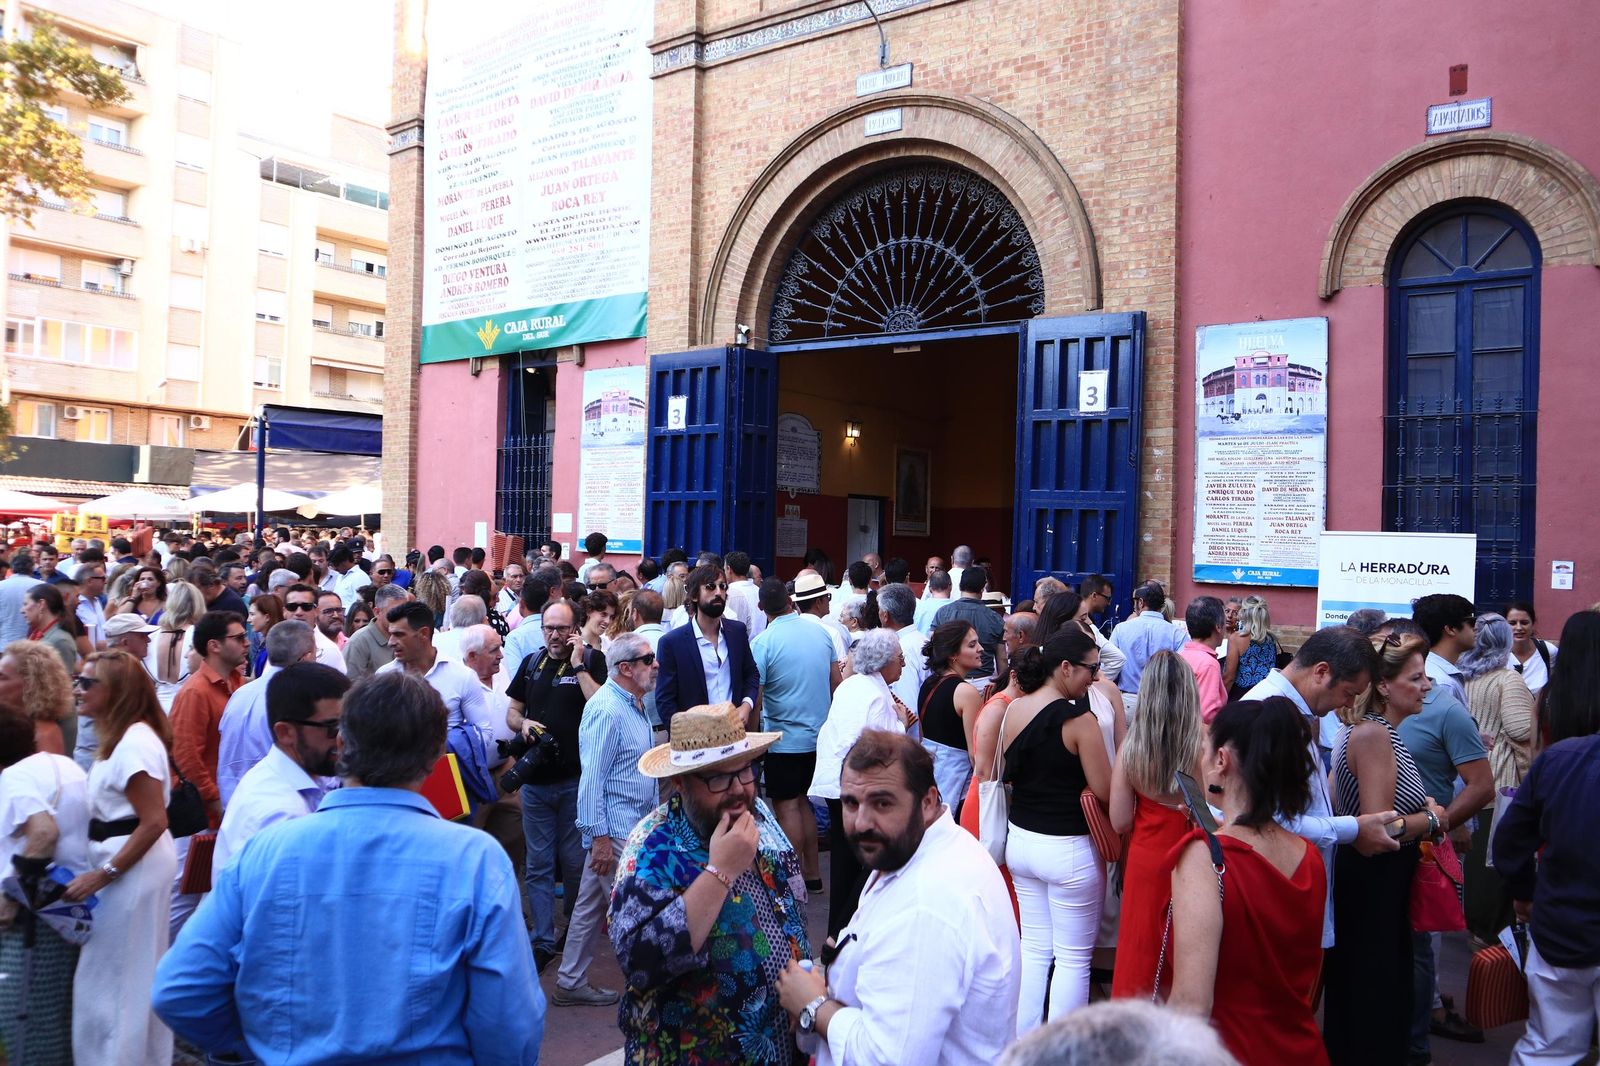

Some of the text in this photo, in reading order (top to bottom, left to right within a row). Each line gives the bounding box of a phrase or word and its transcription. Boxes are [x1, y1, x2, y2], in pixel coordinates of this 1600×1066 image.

[530, 90, 560, 109] DAVID
[578, 71, 634, 94] MIRANDA
[474, 95, 520, 118] ZULUETA
[1432, 106, 1486, 127] APARTADOS
[488, 113, 514, 130] TORO
[439, 128, 518, 161] CARLOS TIRADO
[528, 150, 636, 182] ALEJANDRO TALAVANTE
[540, 170, 619, 196] JUAN ORTEGA
[438, 188, 476, 208] MORANTE
[485, 186, 492, 196] LA
[492, 179, 514, 192] PUEBLA
[481, 194, 512, 213] PERERA
[552, 190, 606, 212] ROCA REY
[448, 213, 504, 238] DANIEL LUQUE
[532, 218, 560, 228] VENTA
[562, 210, 595, 222] ONLINE
[576, 216, 606, 226] JUNIO
[436, 242, 468, 254] DOMINGO
[486, 228, 518, 242] AGOSTO
[443, 252, 468, 262] Corrida
[478, 244, 504, 255] Rejones
[442, 262, 508, 286] DIEGO VENTURA
[474, 276, 510, 292] ROMERO
[504, 314, 566, 334] CAJA RURAL
[522, 330, 550, 341] DEL SUR
[1086, 386, 1098, 406] 3
[672, 408, 681, 424] 3
[1340, 562, 1450, 575] LA HERRADURA
[1381, 577, 1433, 586] MONACILLA
